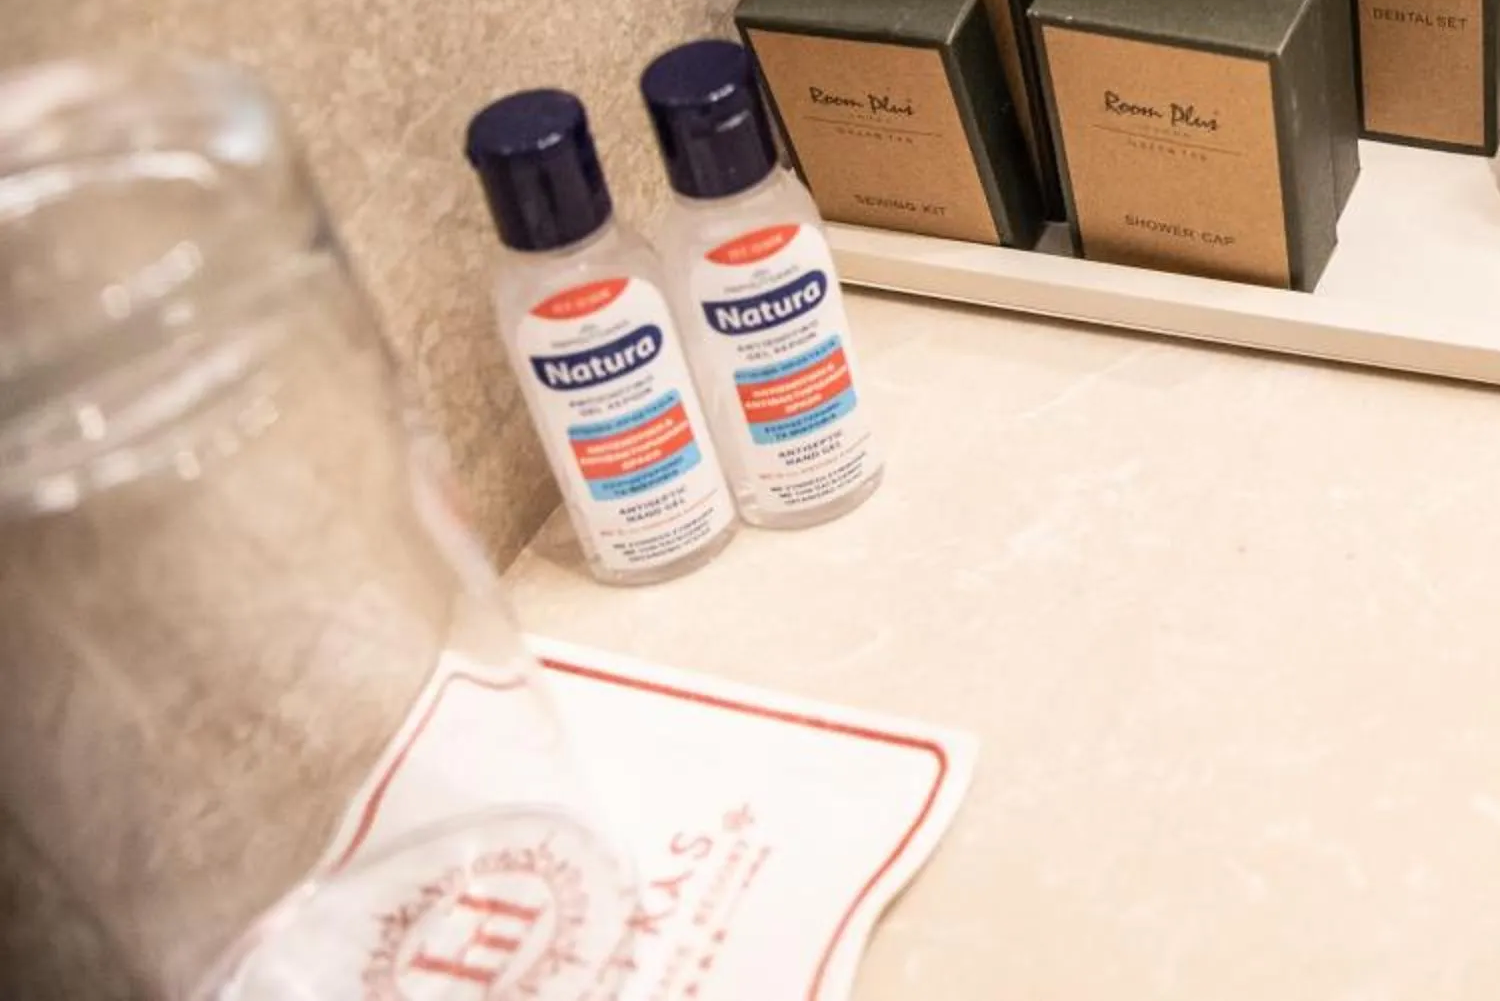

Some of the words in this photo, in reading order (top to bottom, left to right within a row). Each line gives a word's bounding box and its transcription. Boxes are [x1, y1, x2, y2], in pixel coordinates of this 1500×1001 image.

[1372, 6, 1433, 27] DENTAL
[1436, 15, 1469, 31] SET
[809, 86, 864, 108] Room
[867, 93, 915, 116] Plus
[1103, 90, 1163, 118] Room
[1169, 102, 1219, 131] Plus
[922, 201, 947, 216] KIT
[1124, 213, 1196, 240] SHOWER
[1200, 230, 1236, 247] CAP
[715, 280, 821, 331] Natura
[545, 336, 656, 387] Natura
